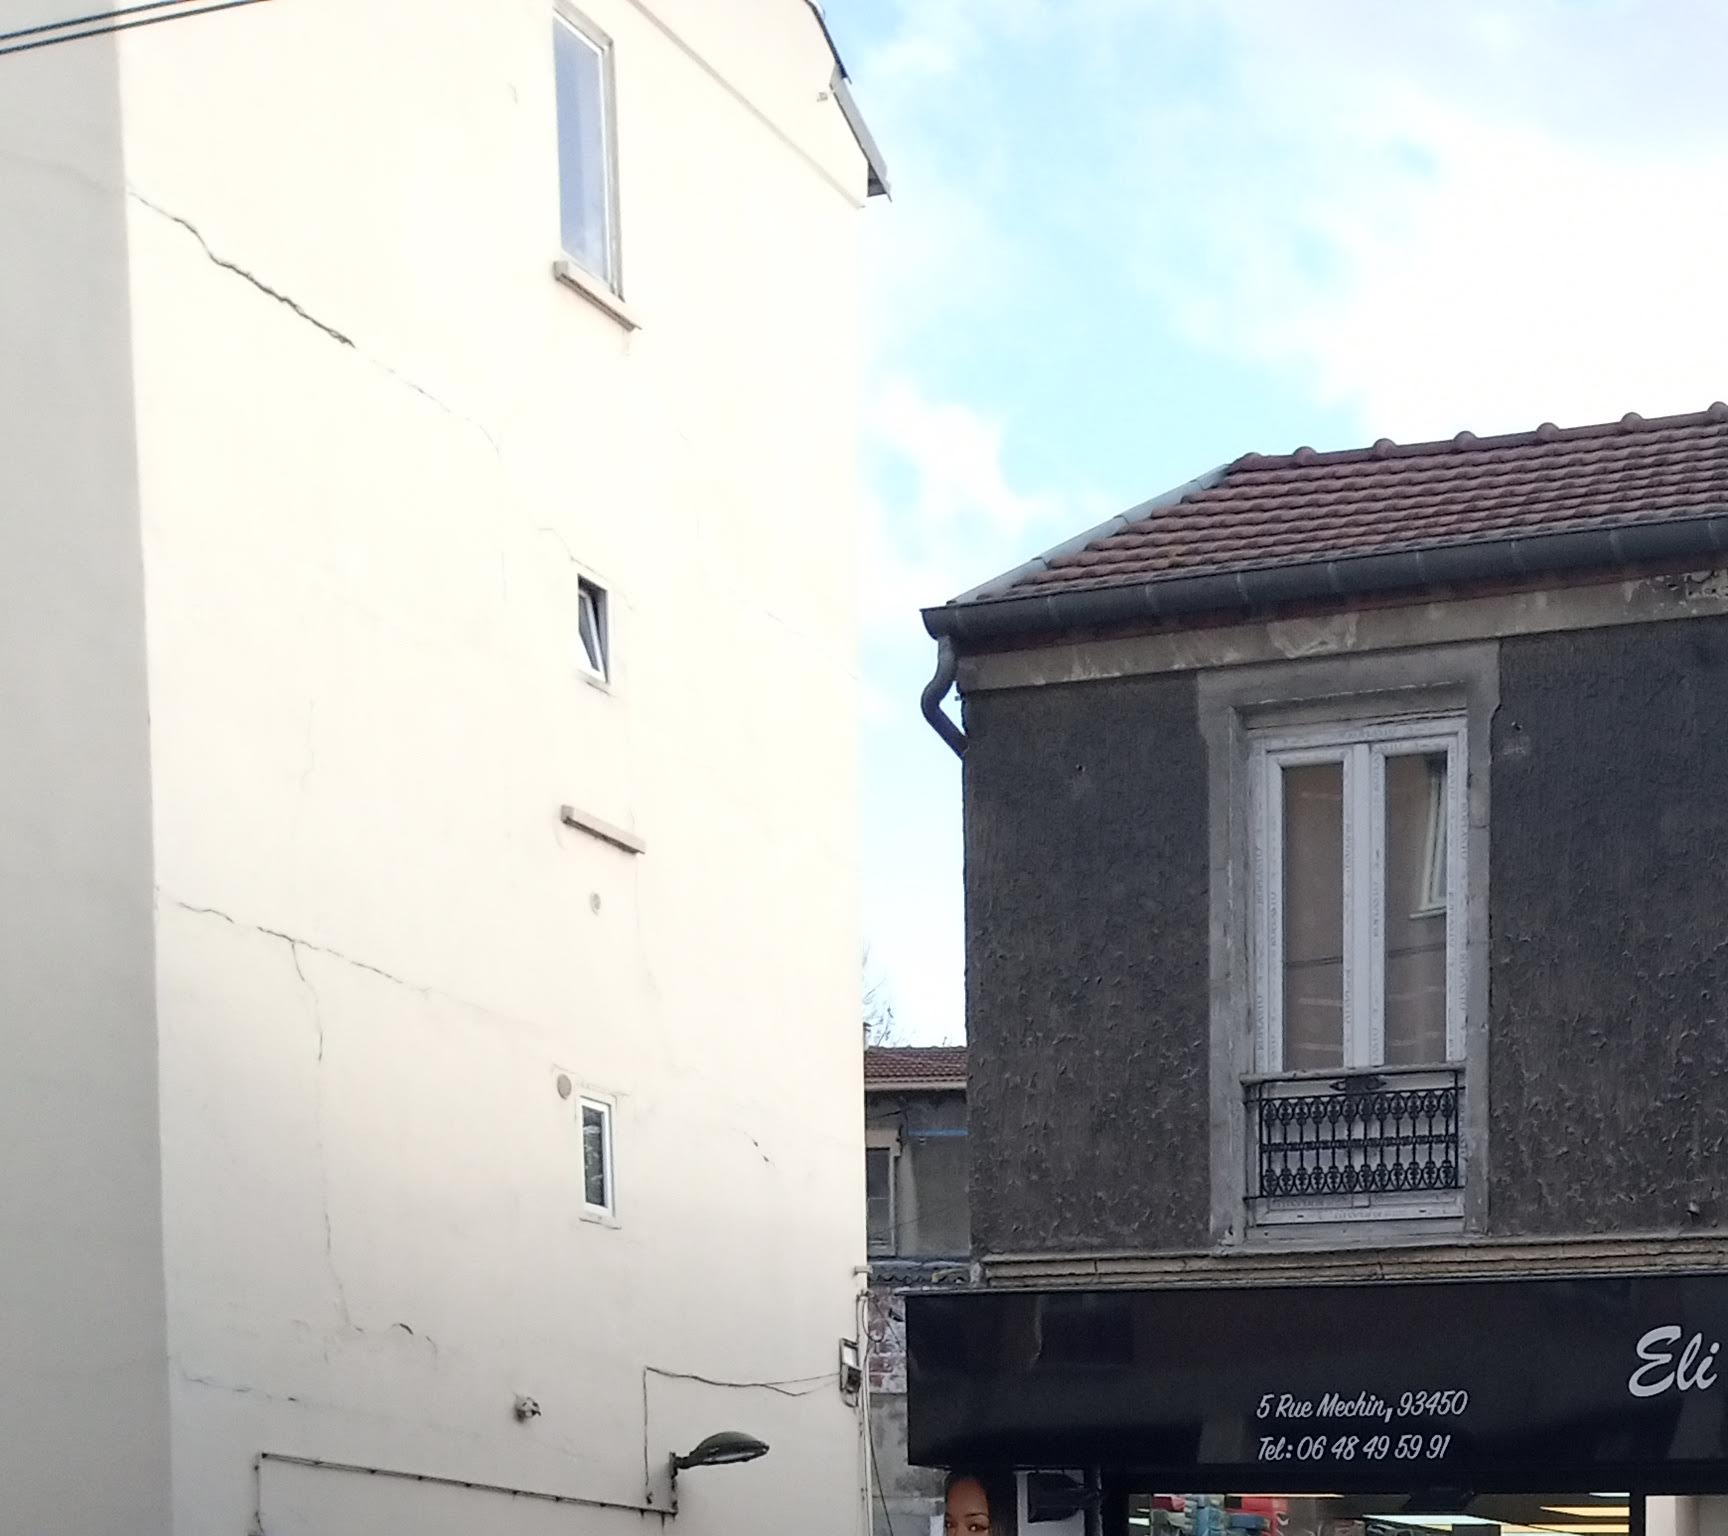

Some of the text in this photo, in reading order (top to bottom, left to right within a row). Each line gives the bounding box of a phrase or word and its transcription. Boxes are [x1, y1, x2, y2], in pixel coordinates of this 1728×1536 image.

[1628, 1325, 1720, 1398] Eli
[1256, 1388, 1469, 1423] 5 Rue Mechin, 93450
[1258, 1434, 1452, 1461] Tel: 06 48 49 59 91
